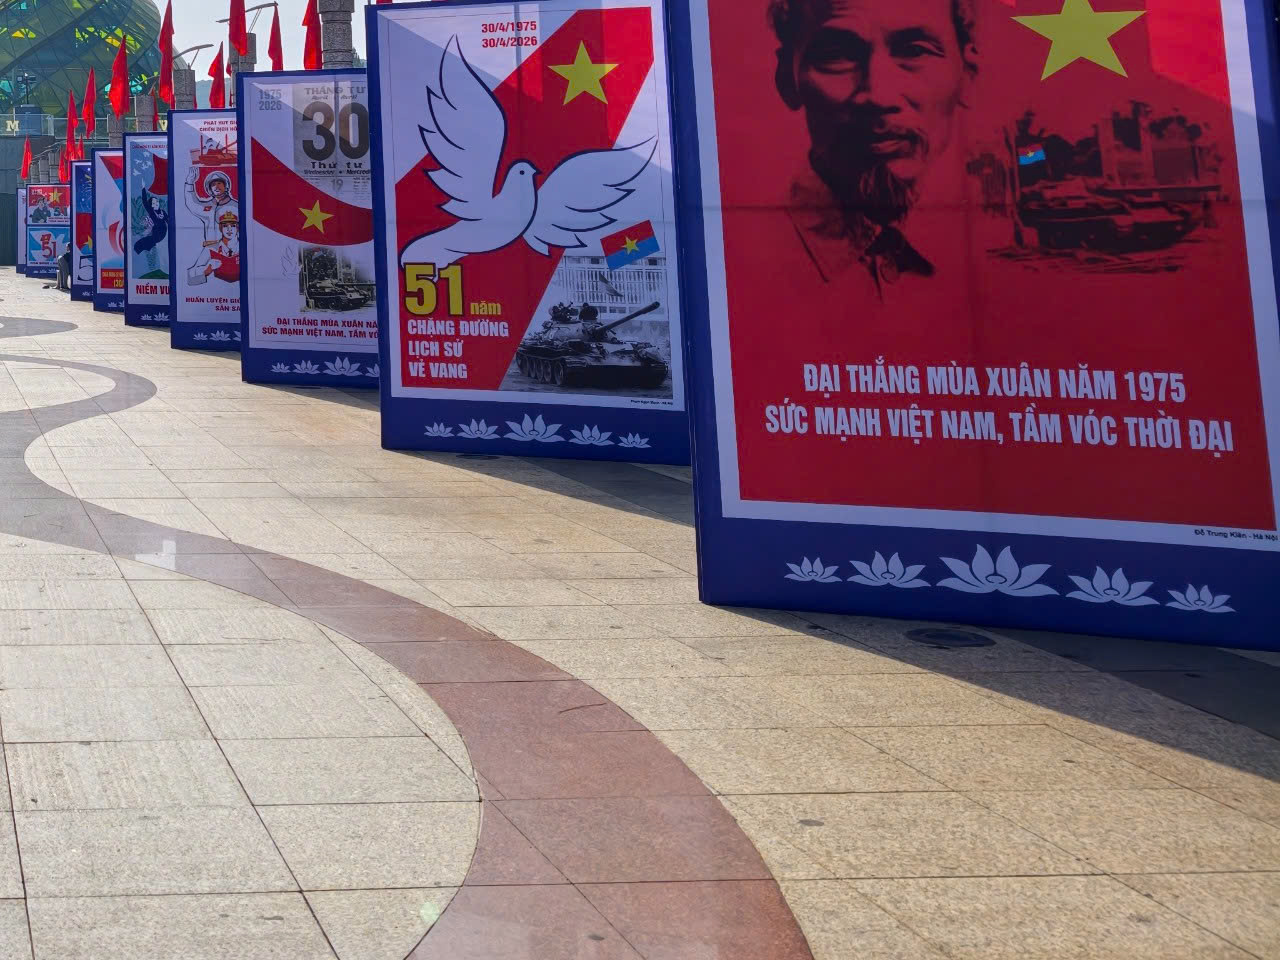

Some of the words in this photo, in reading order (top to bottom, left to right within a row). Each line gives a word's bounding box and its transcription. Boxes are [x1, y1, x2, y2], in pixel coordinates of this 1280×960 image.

[481, 21, 537, 33] 30/4/1975
[482, 36, 537, 48] 30/4/2026
[259, 89, 282, 100] 1975
[259, 100, 282, 111] 2026
[303, 101, 370, 161] 30
[311, 161, 337, 169] Thứ
[346, 161, 366, 169] tư
[136, 282, 158, 295] NIỀM
[404, 262, 464, 316] 51
[470, 300, 502, 315] năm
[276, 317, 290, 327] ĐẠI
[292, 317, 319, 327] THẮNG
[320, 318, 339, 327] MÙA
[341, 319, 364, 328] XUÂN
[408, 317, 455, 338] CHẶNG
[460, 319, 509, 337] ĐƯỜNG
[262, 326, 278, 335] SỨC
[280, 328, 304, 337] MẠNH
[306, 327, 323, 338] VIỆT
[348, 329, 366, 338] TẦM
[408, 340, 439, 359] LỊCH
[443, 338, 464, 357] SỬ
[408, 358, 426, 378] VẺ
[429, 362, 468, 379] VANG
[803, 363, 841, 398] ĐẠI
[845, 355, 920, 394] THẮNG
[927, 360, 980, 396] MÙA
[986, 361, 1052, 398] XUÂN
[1058, 363, 1117, 400] NĂM
[1124, 371, 1186, 403] 1975
[765, 397, 809, 434] SỨC
[815, 407, 882, 442] MẠNH
[887, 403, 934, 445] VIỆT
[940, 410, 1004, 445] NAM,
[1009, 402, 1063, 444] TẦM
[1068, 409, 1118, 446] VÓC
[1124, 410, 1182, 449] THỜI
[1188, 419, 1234, 458] ĐẠI
